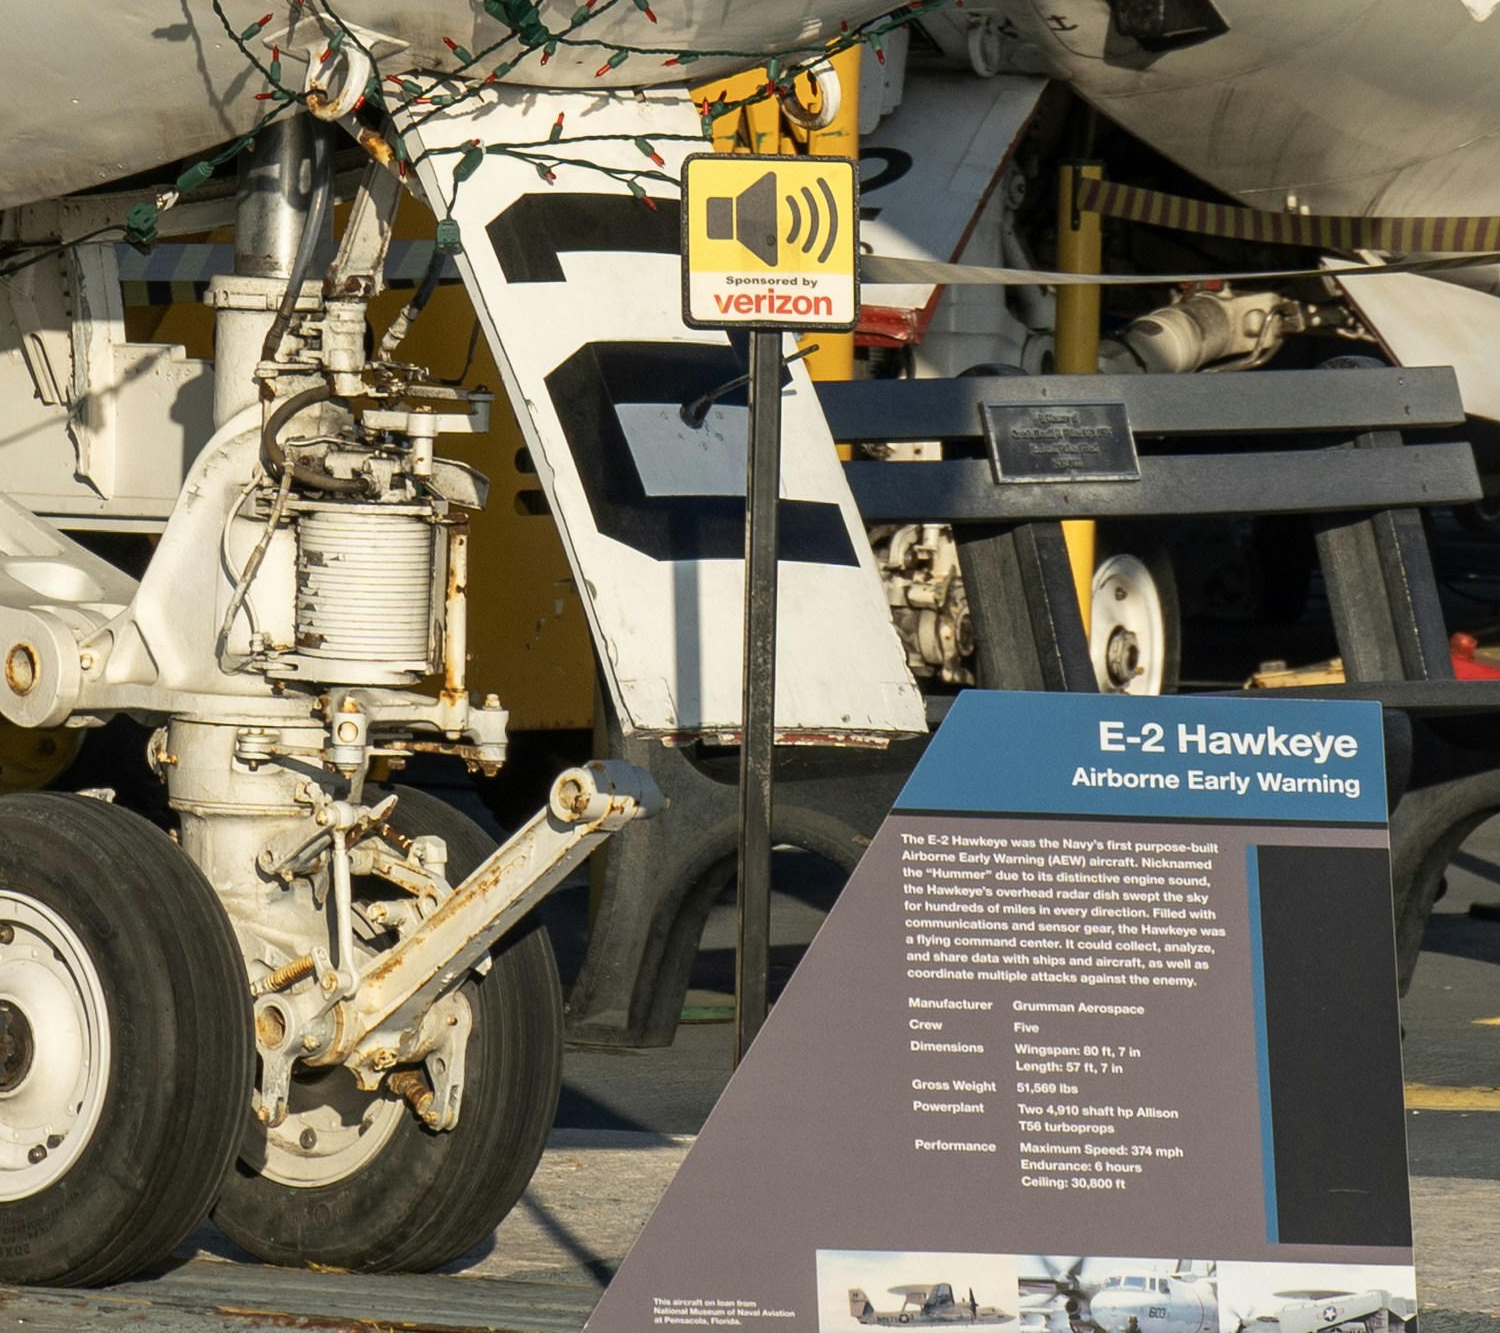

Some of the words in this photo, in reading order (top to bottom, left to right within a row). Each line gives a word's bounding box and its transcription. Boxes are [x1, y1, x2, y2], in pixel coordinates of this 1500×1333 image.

[725, 275, 798, 287] Sponsored
[802, 277, 818, 289] by
[713, 288, 833, 316] verizon
[1099, 720, 1165, 752] E-2
[1177, 723, 1358, 764] Hawkeye
[1071, 766, 1180, 789] Airborne
[1187, 769, 1250, 795] Early
[1256, 771, 1360, 798] Warning
[900, 833, 925, 845] The
[927, 834, 949, 845] E-2
[951, 835, 1008, 849] Hawkeye
[1010, 839, 1036, 848] was
[1038, 837, 1060, 849] the
[1106, 839, 1132, 851] first
[1134, 842, 1219, 854] purpose-built
[901, 850, 956, 862] Airborne
[958, 851, 991, 865] Early
[992, 853, 1045, 867] Warning
[1047, 854, 1086, 868] (AEW)
[1089, 855, 1138, 867] aircraft.
[1141, 857, 1212, 870] Nicknamed
[902, 866, 923, 878] the
[994, 869, 1019, 881] due
[1021, 871, 1035, 881] to
[1037, 871, 1053, 882] its
[1056, 871, 1120, 884] distinctive
[1122, 874, 1165, 887] engine
[1167, 876, 1211, 888] sound,
[903, 883, 924, 894] the
[995, 887, 1053, 899] overhead
[1056, 888, 1090, 899] radar
[1092, 889, 1119, 900] dish
[1122, 891, 1160, 903] swept
[1162, 891, 1183, 902] the
[1186, 892, 1209, 905] sky
[904, 900, 922, 911] for
[924, 900, 984, 913] hundreds
[986, 903, 1000, 913] of
[1002, 903, 1036, 915] miles
[1039, 904, 1051, 915] in
[1053, 906, 1088, 918] every
[1090, 906, 1150, 918] direction.
[1152, 907, 1186, 919] Filled
[1188, 909, 1216, 920] with
[904, 918, 1009, 930] communications
[1011, 920, 1035, 931] and
[1037, 923, 1081, 933] sensor
[1083, 924, 1115, 935] gear,
[1117, 923, 1138, 934] the
[1141, 923, 1197, 938] Hawkeye
[1199, 927, 1226, 937] was
[905, 935, 914, 944] a
[916, 933, 951, 948] flying
[953, 936, 1017, 947] command
[1019, 938, 1062, 949] center.
[1065, 938, 1074, 949] It
[1077, 939, 1112, 950] could
[1114, 940, 1161, 953] collect,
[1163, 941, 1215, 954] analyze,
[906, 950, 930, 962] and
[933, 951, 968, 963] share
[971, 952, 999, 963] data
[1002, 953, 1029, 964] with
[1032, 954, 1066, 967] ships
[1068, 955, 1093, 966] and
[1095, 956, 1145, 969] aircraft,
[1148, 959, 1163, 969] as
[1165, 958, 1191, 969] well
[1193, 961, 1209, 970] as
[907, 968, 974, 980] coordinate
[977, 969, 1028, 982] multiple
[1030, 971, 1077, 983] attacks
[1080, 973, 1126, 985] against
[1128, 974, 1150, 985] the
[1152, 976, 1197, 988] enemy.
[908, 997, 993, 1010] Manufacturer
[1012, 1000, 1075, 1012] Grumman
[1077, 1002, 1145, 1016] Aerospace
[908, 1018, 943, 1030] Crew
[1013, 1021, 1039, 1033] Five
[910, 1040, 984, 1053] Dimensions
[1014, 1043, 1080, 1057] Wingspan:
[1083, 1045, 1099, 1056] 80
[1101, 1045, 1115, 1058] ft,
[1117, 1046, 1126, 1057] 7
[1128, 1046, 1141, 1057] in
[1015, 1060, 1063, 1074] Length:
[1066, 1061, 1081, 1072] 57
[1083, 1062, 1098, 1074] ft,
[1100, 1062, 1108, 1073] 7
[1111, 1063, 1123, 1073] in
[911, 1078, 950, 1090] Gross
[952, 1079, 996, 1094] Weight
[1016, 1082, 1057, 1094] 51,569
[1059, 1083, 1078, 1094] lbs
[913, 1100, 984, 1114] Powerplant
[1017, 1103, 1043, 1115] Two
[1046, 1104, 1079, 1116] 4,910
[1081, 1105, 1114, 1117] shaft
[1117, 1106, 1134, 1119] hp
[1136, 1106, 1179, 1119] Allison
[1018, 1120, 1042, 1132] T56
[1044, 1121, 1115, 1135] turboprops
[914, 1138, 996, 1152] Performance
[1019, 1142, 1081, 1154] Maximum
[1084, 1143, 1128, 1157] Speed:
[1131, 1145, 1153, 1156] 374
[1155, 1146, 1184, 1159] mph
[1020, 1158, 1092, 1171] Endurance:
[1094, 1160, 1103, 1172] 6
[1105, 1161, 1142, 1173] hours
[1021, 1175, 1068, 1190] Ceiling:
[1071, 1177, 1113, 1190] 30,800
[1115, 1178, 1126, 1189] ft
[653, 1297, 671, 1307] This
[672, 1298, 703, 1307] aircraft
[716, 1299, 735, 1308] loan
[736, 1299, 757, 1308] from
[653, 1307, 688, 1316] National
[689, 1308, 725, 1317] Museum
[726, 1308, 736, 1317] of
[736, 1308, 760, 1317] Naval
[761, 1309, 795, 1318] Aviation
[653, 1316, 663, 1325] at
[663, 1316, 709, 1326] Pensacola,
[710, 1317, 742, 1326] Florida.
